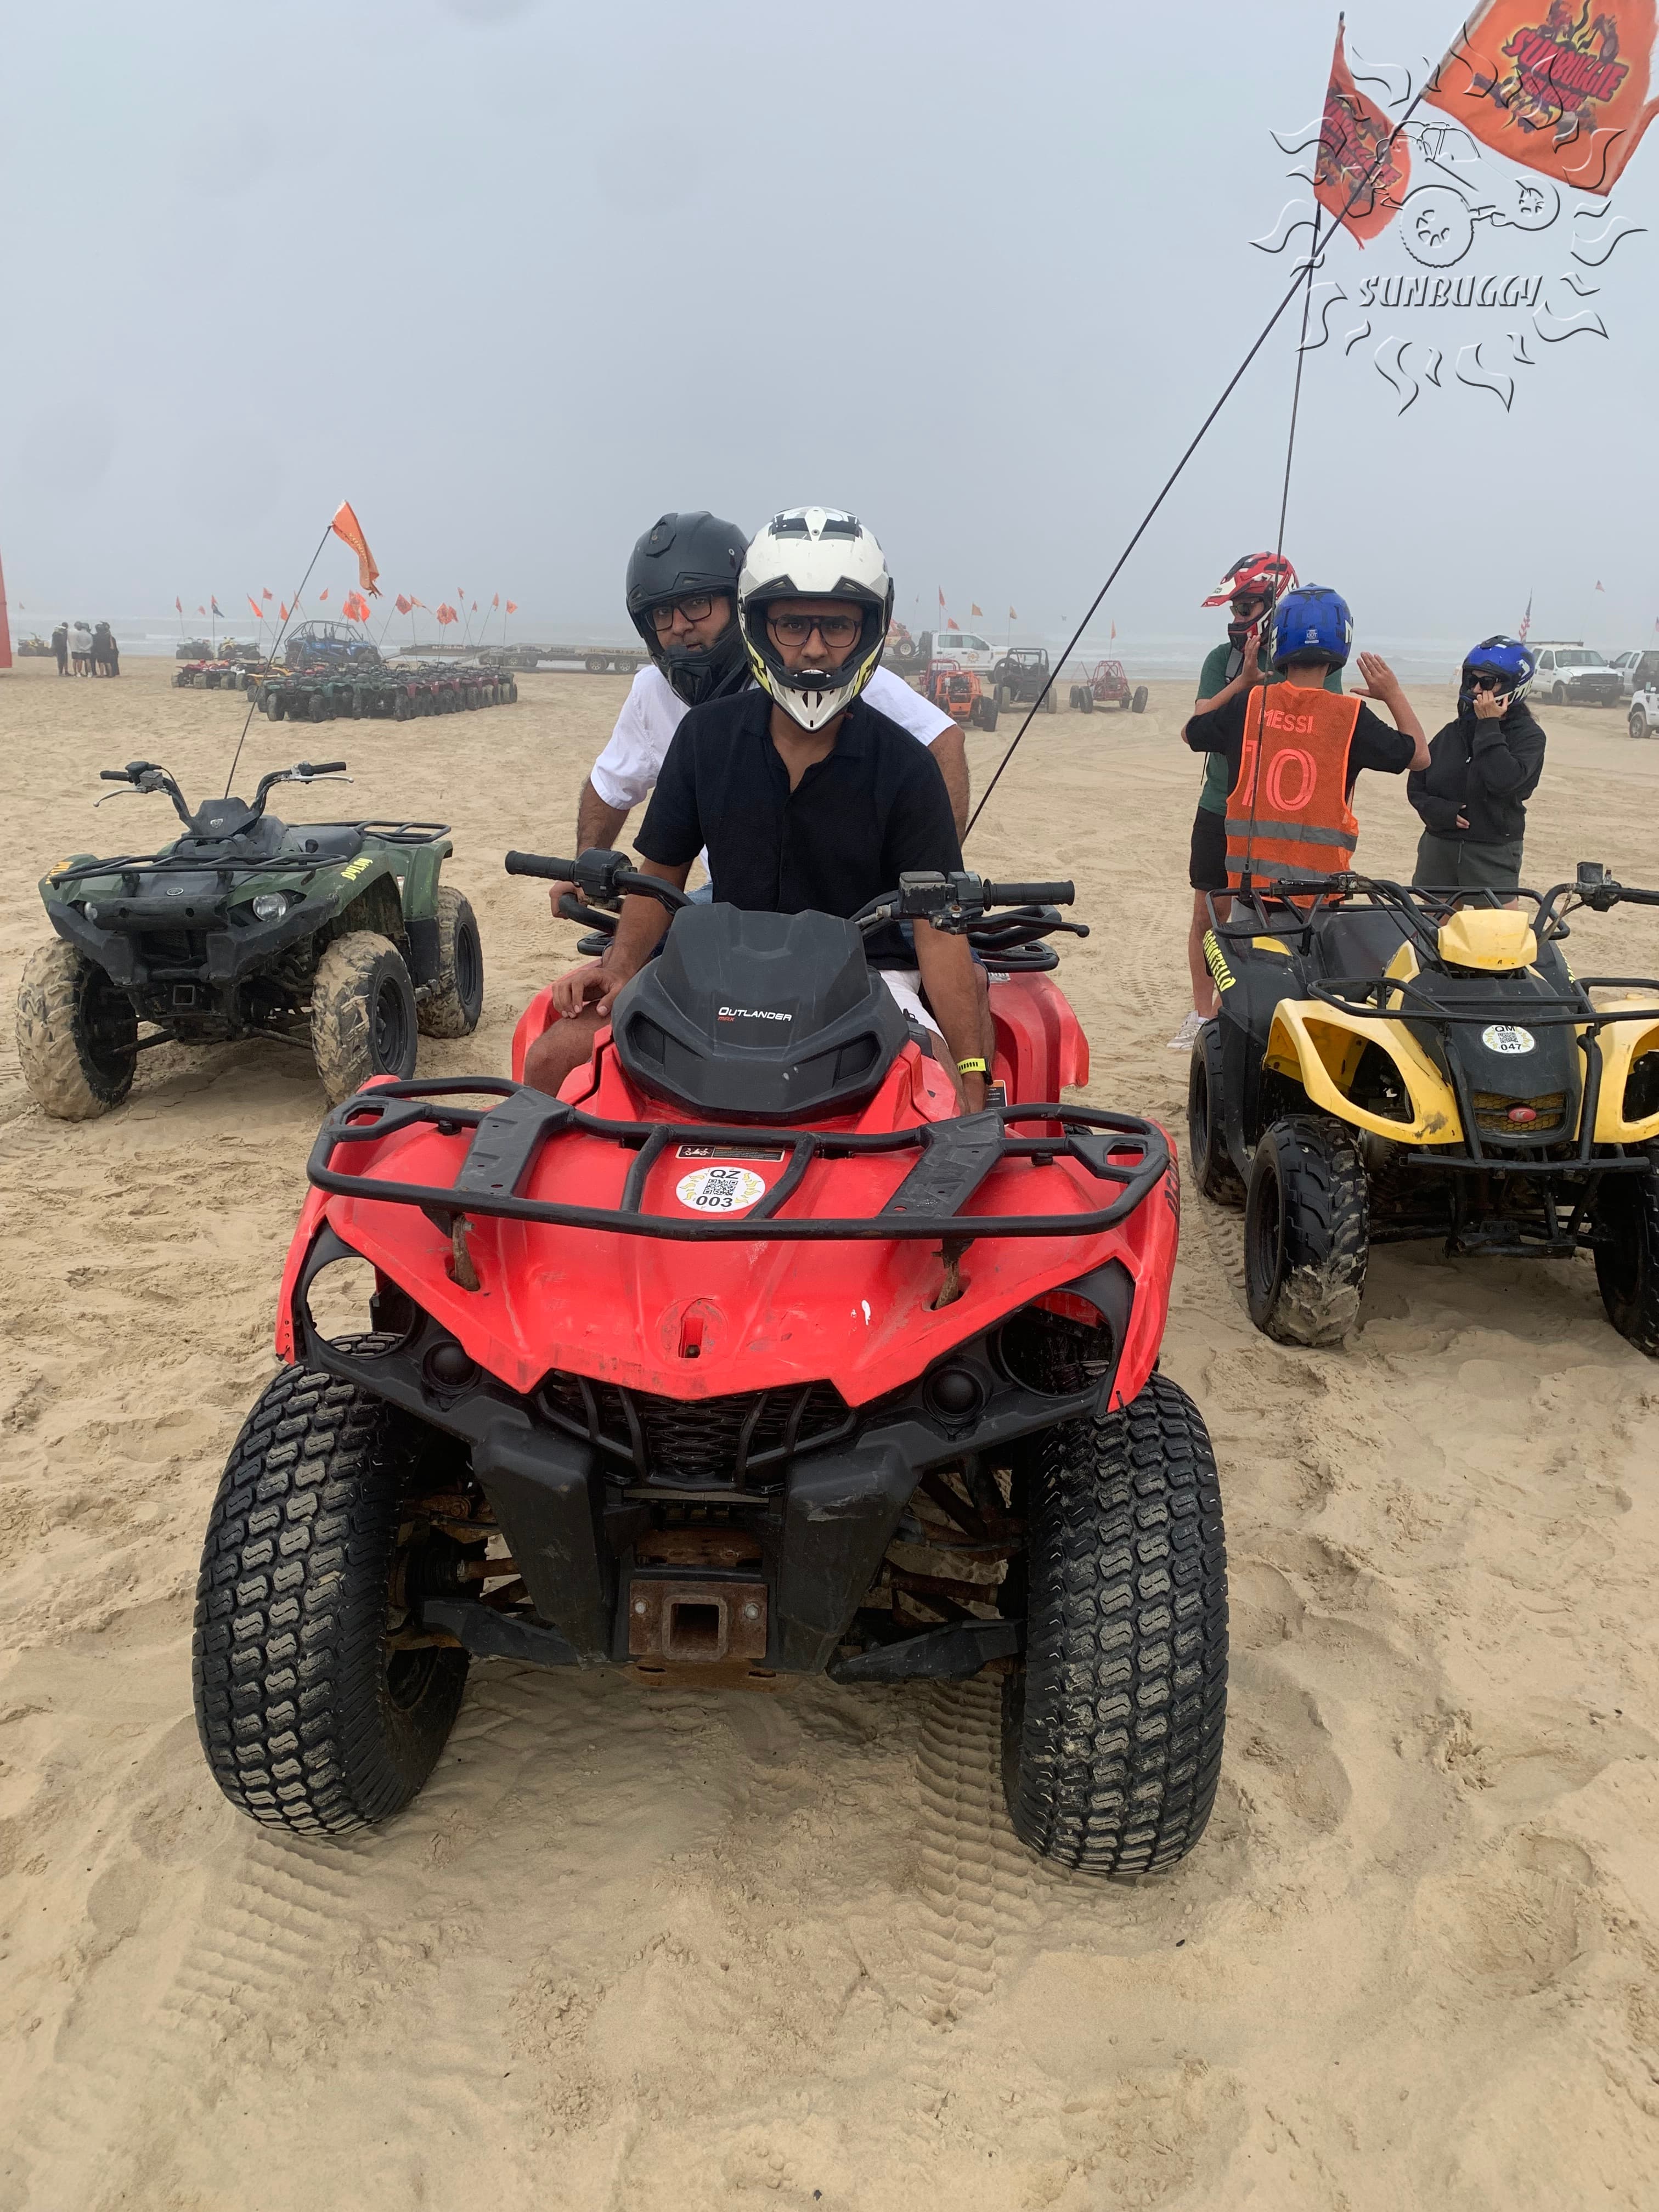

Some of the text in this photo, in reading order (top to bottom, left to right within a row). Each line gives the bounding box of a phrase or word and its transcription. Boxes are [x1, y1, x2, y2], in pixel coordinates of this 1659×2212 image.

[1502, 27, 1629, 101] SUNBUGGIE
[1257, 708, 1313, 733] MESSI
[1242, 740, 1317, 811] 10
[710, 1170, 741, 1179] QZ
[696, 1196, 733, 1207] 003
